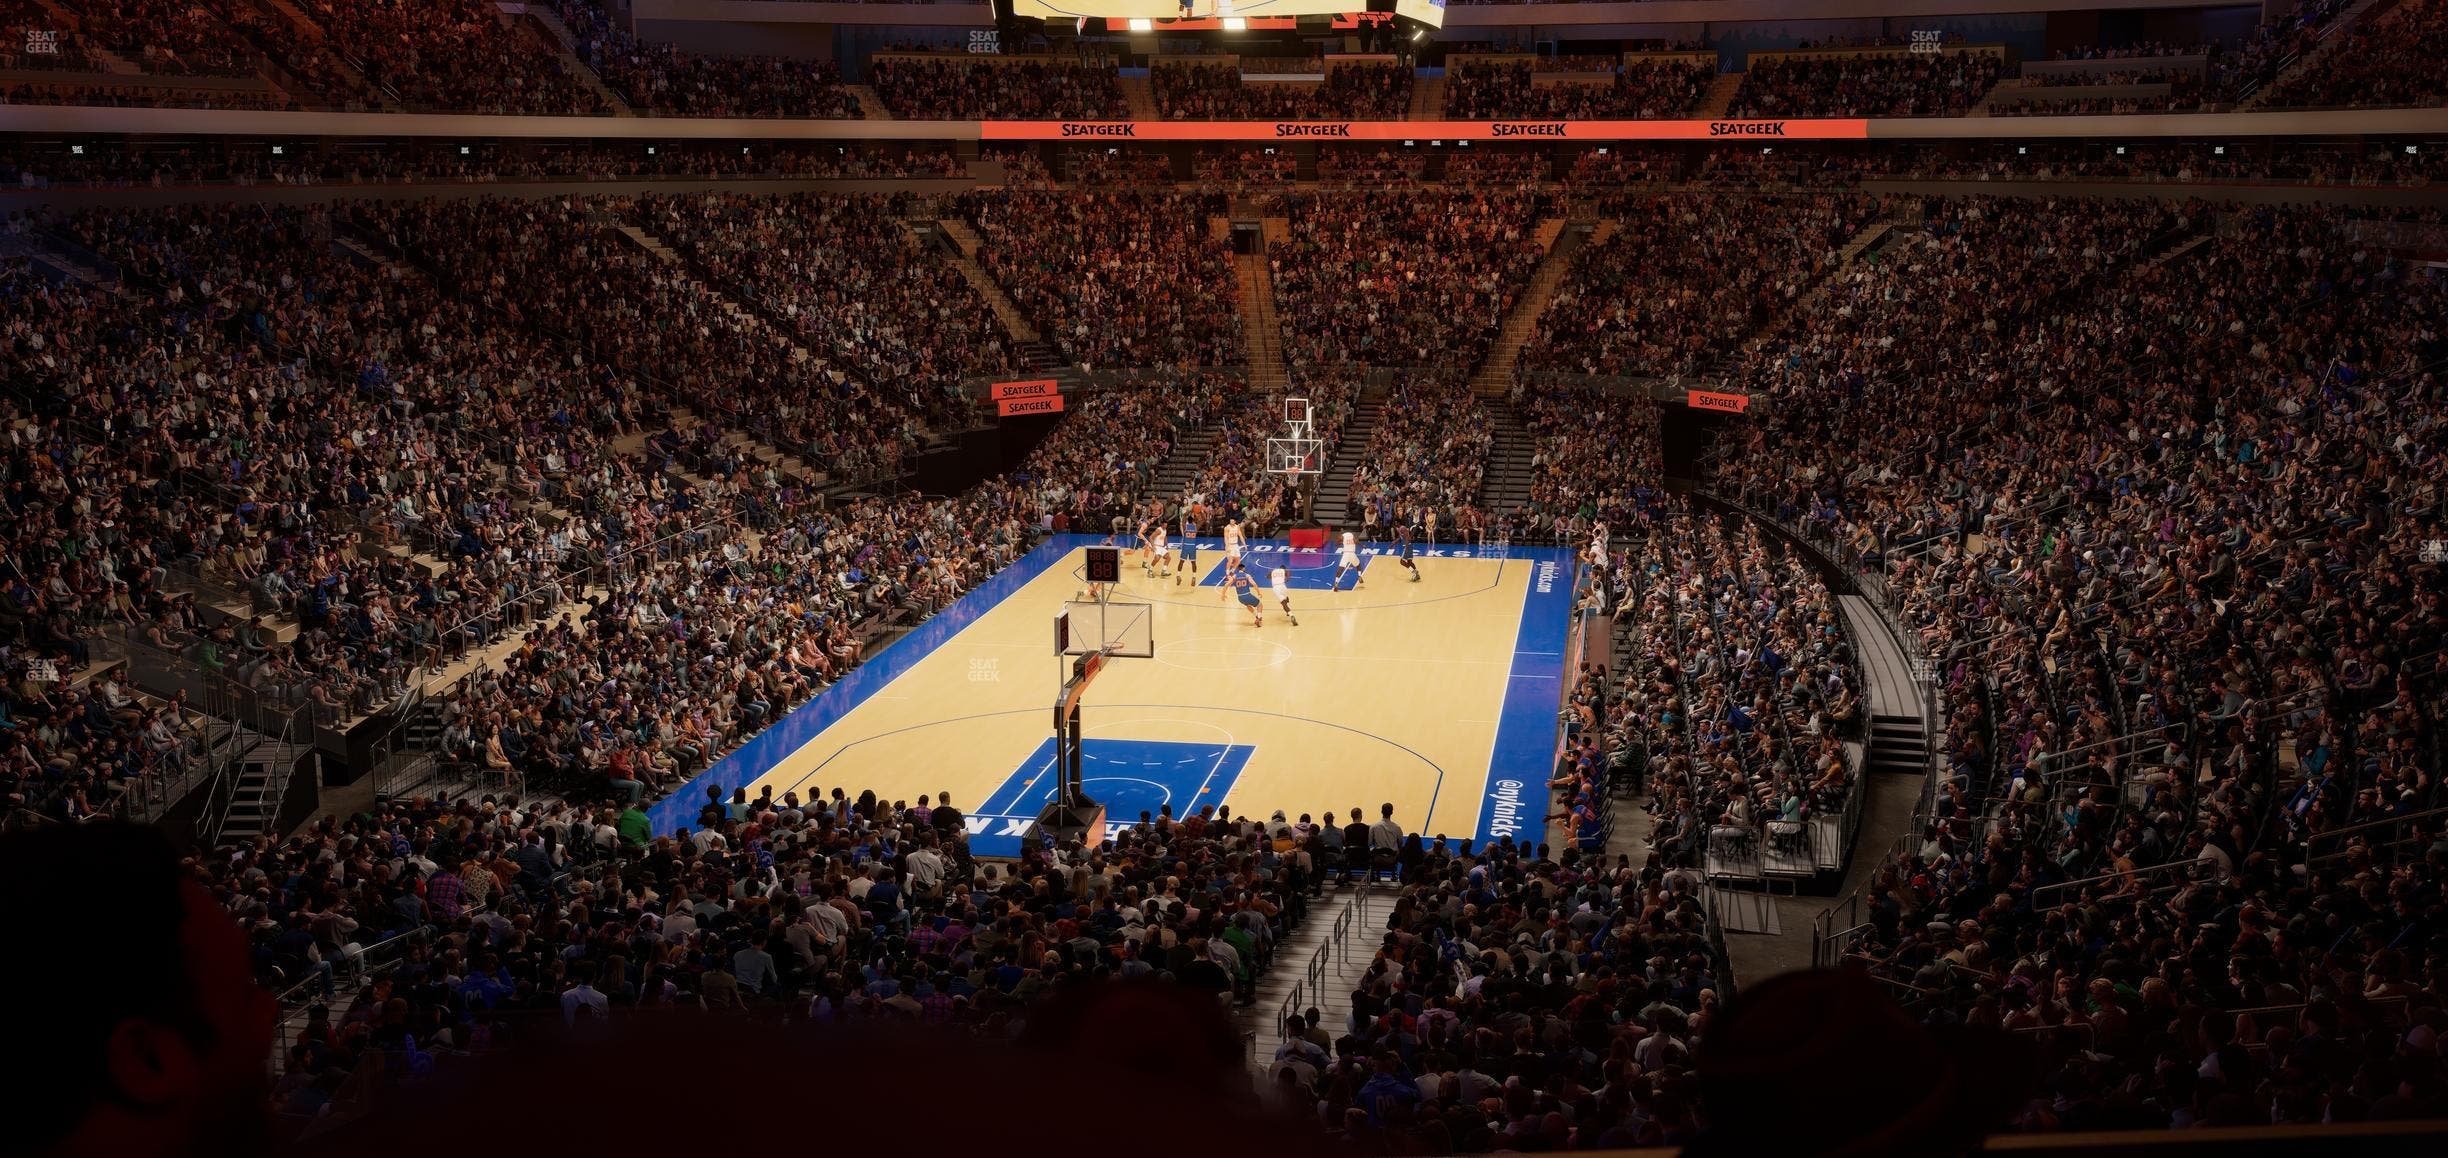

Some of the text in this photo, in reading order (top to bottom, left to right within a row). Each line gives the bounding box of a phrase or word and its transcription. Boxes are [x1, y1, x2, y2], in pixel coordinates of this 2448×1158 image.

[1062, 123, 1136, 137] SEATGEEK
[1276, 123, 1350, 137] SEATGEEK
[1492, 123, 1567, 137] SEATGEEK
[1710, 122, 1785, 136] SEATGEEK
[1002, 384, 1046, 397] SEATGEEK
[1009, 400, 1052, 413] SEATGEEK
[1699, 395, 1739, 410] SEATGEEK
[1489, 779, 1526, 838] @nyknicks
